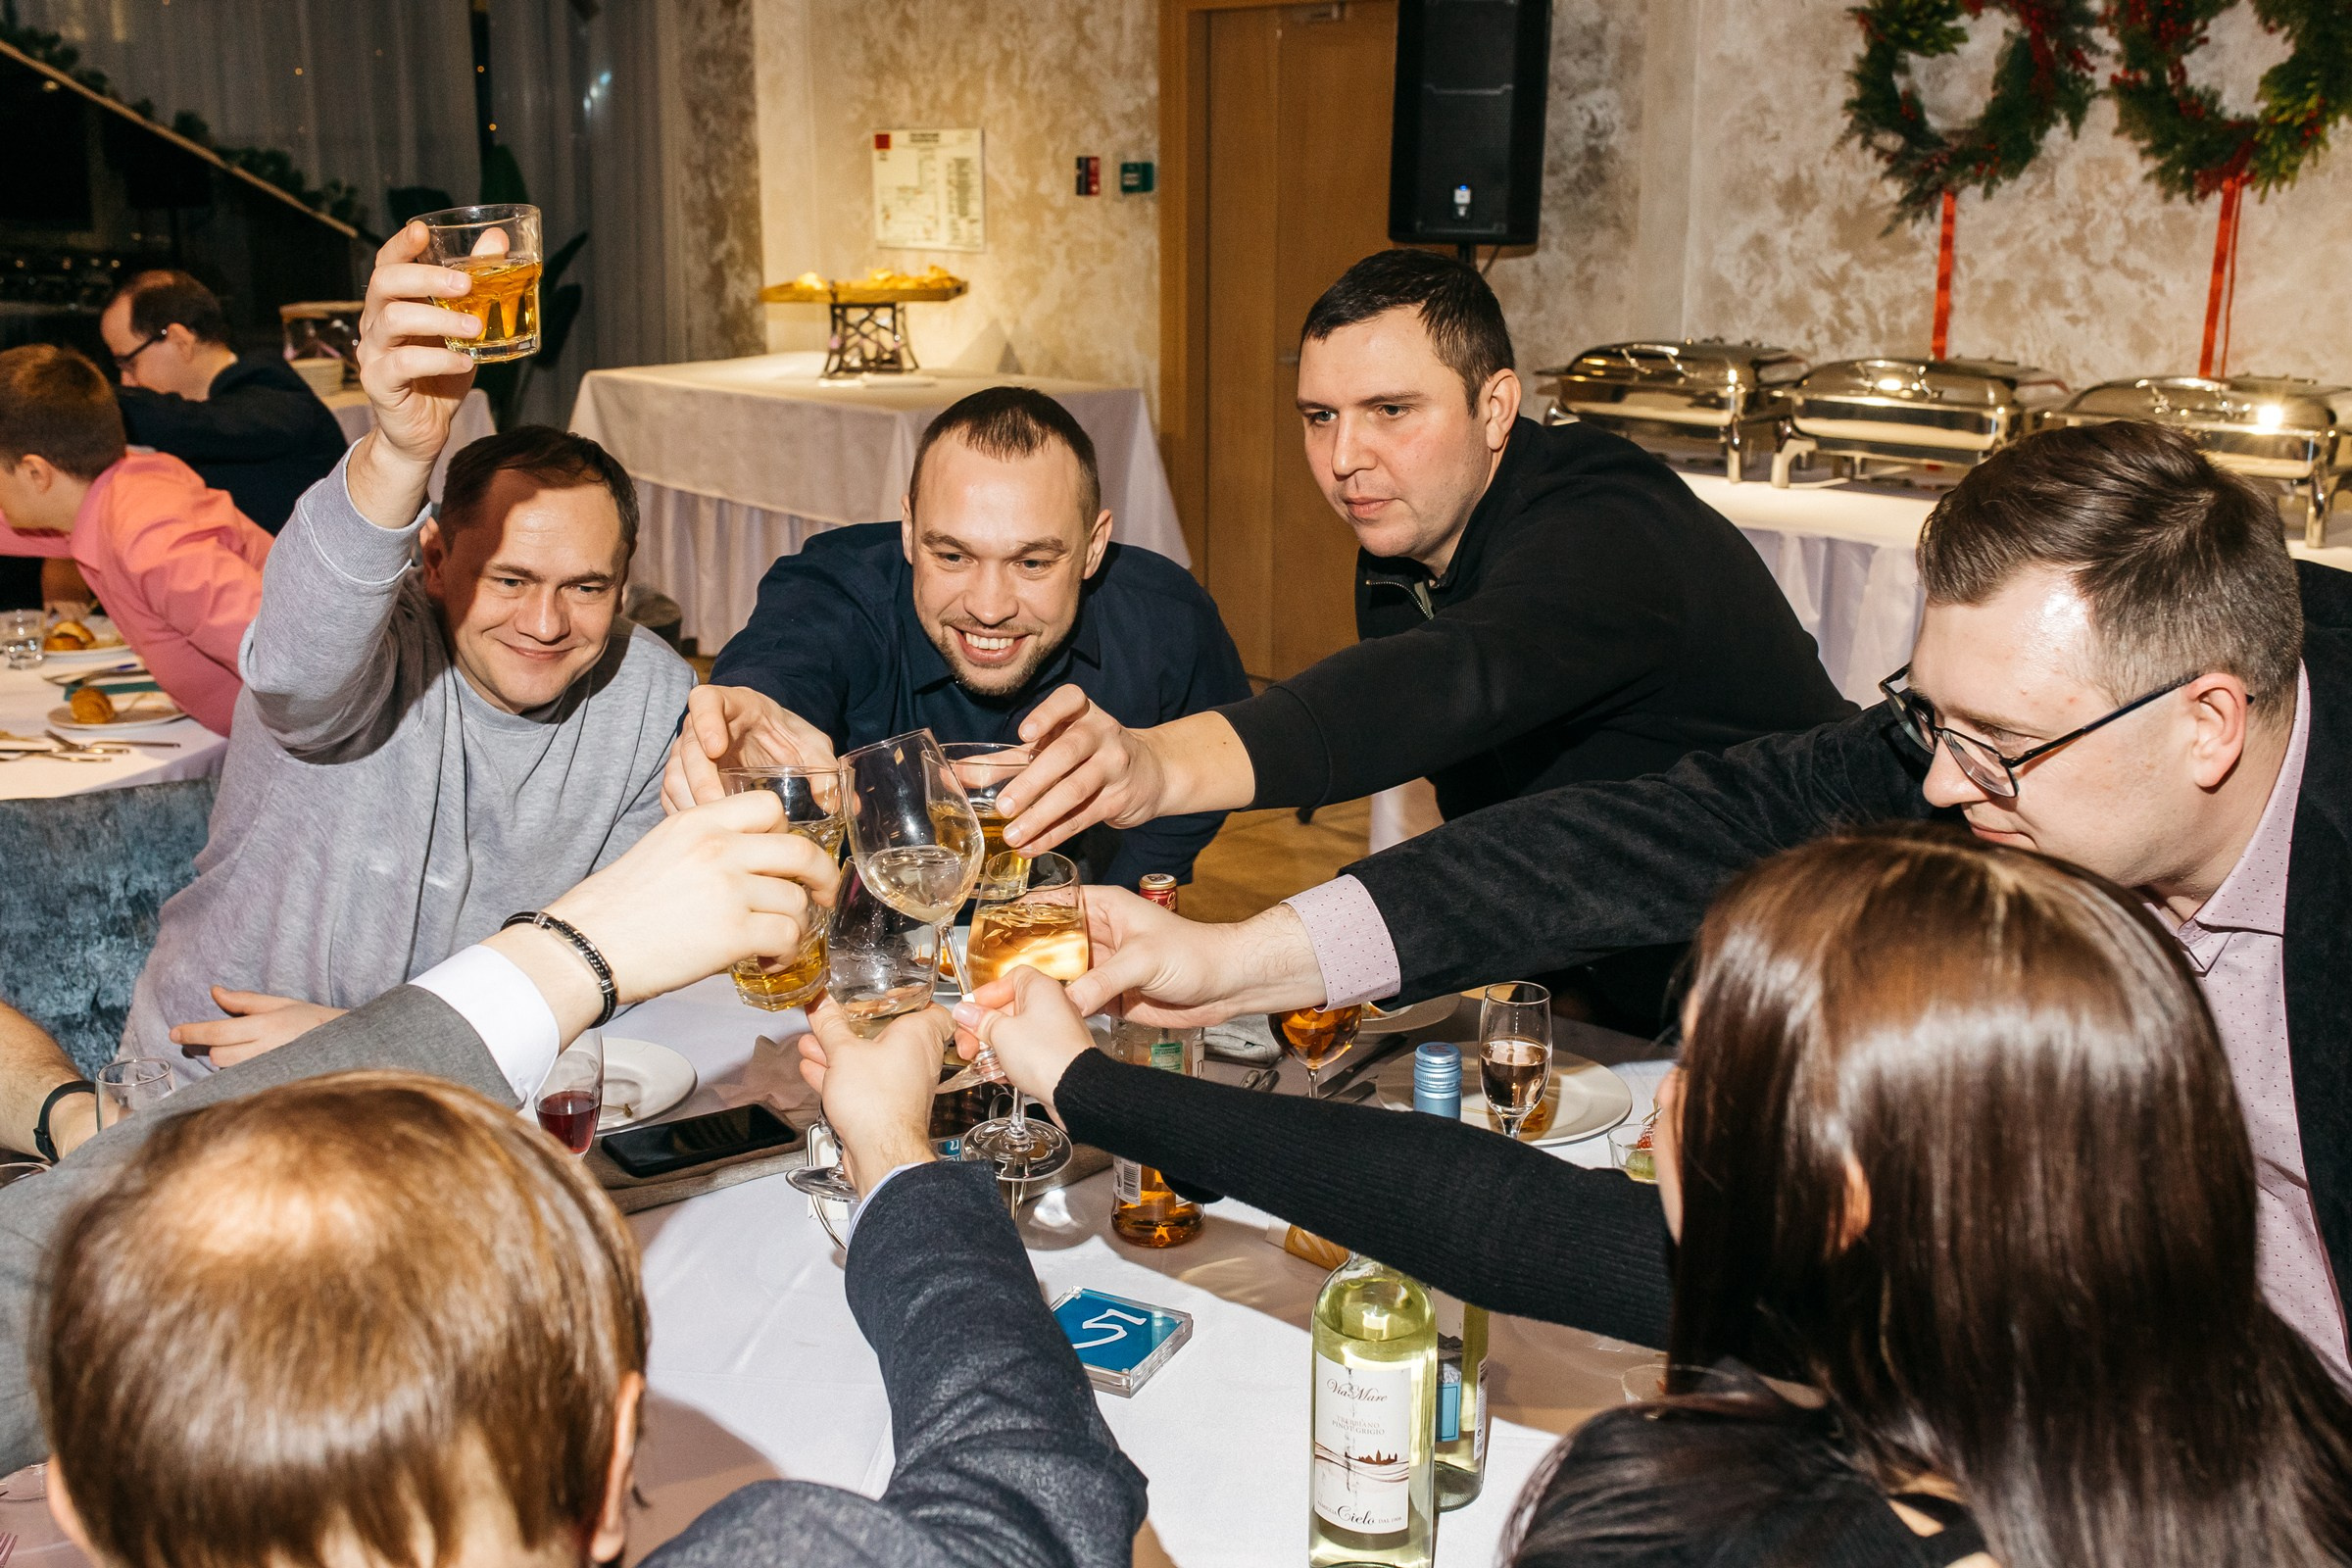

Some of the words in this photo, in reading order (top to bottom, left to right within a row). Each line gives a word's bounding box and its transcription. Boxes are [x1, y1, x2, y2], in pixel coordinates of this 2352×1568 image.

[1327, 1378, 1349, 1397] Via
[1348, 1384, 1388, 1402] Mare
[1332, 1419, 1353, 1432] PINOT
[1355, 1426, 1385, 1436] GRIGIO
[1337, 1505, 1375, 1526] Cielo
